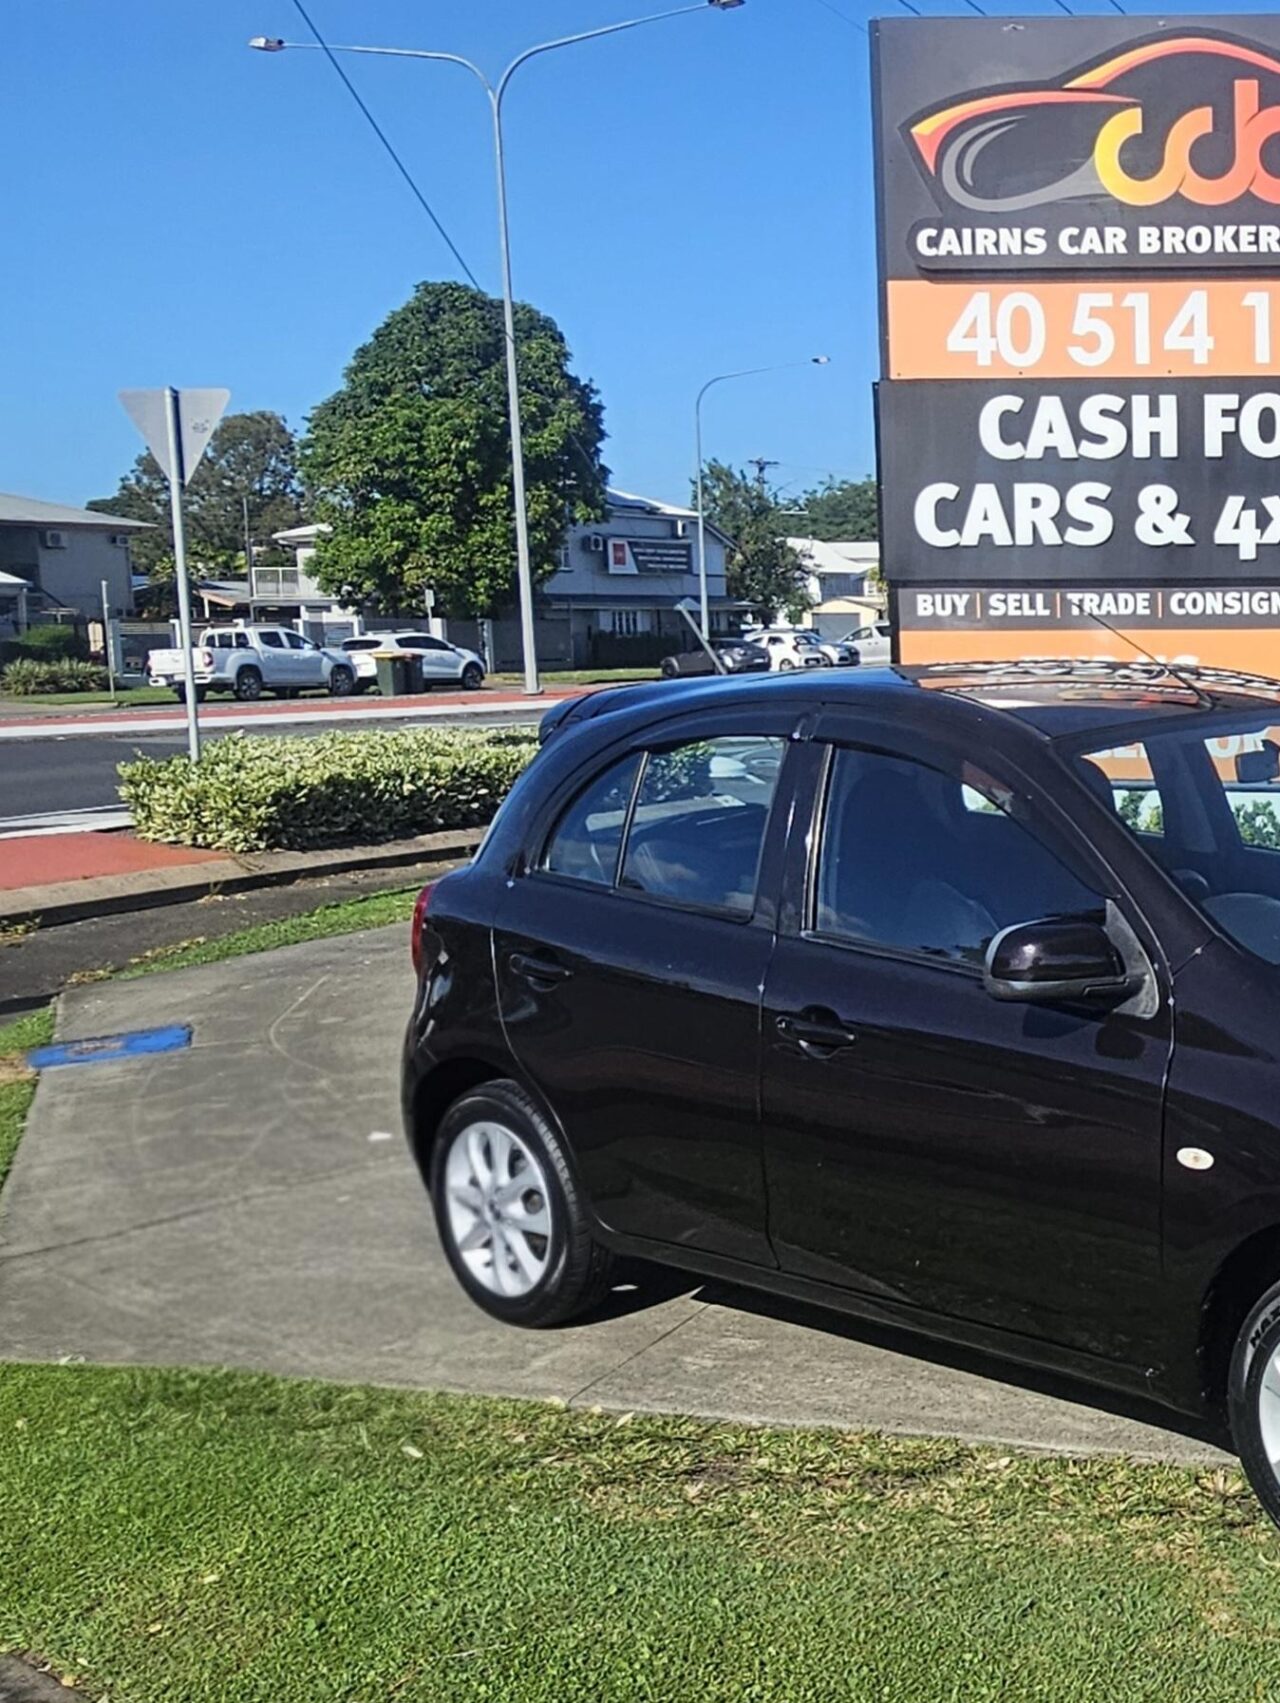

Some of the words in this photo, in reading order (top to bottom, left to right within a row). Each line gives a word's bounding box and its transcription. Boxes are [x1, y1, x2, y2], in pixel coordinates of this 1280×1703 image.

[916, 227, 1047, 256] CAIRNS
[1058, 226, 1128, 255] CAR
[946, 291, 1046, 367] 40
[1067, 290, 1214, 367] 514
[978, 394, 1178, 460] CASH
[914, 483, 1114, 547] CARS
[1134, 484, 1196, 545] &
[917, 594, 969, 616] BUY
[988, 593, 1051, 616] SELL
[1069, 592, 1151, 616] TRADE
